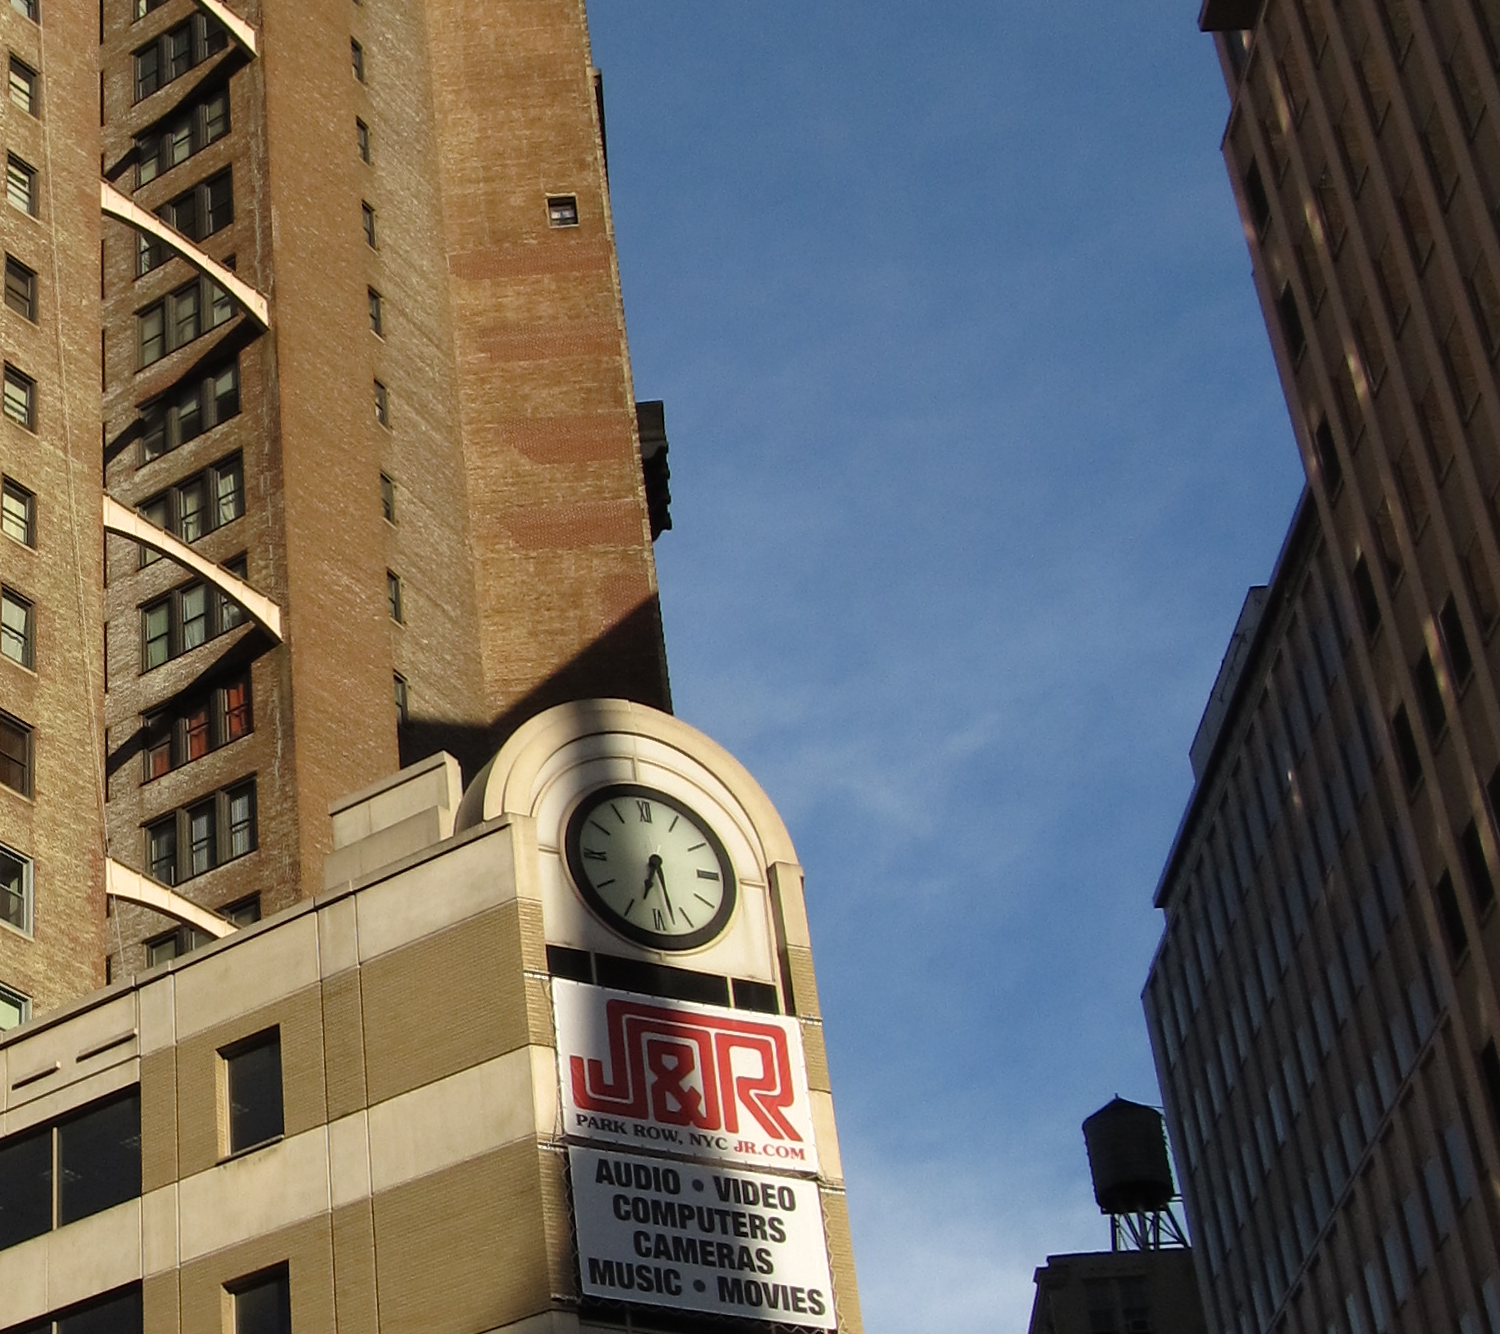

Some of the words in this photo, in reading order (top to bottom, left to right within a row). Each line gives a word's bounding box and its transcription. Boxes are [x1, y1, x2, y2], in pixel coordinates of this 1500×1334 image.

[570, 998, 803, 1142] J&R
[575, 1113, 628, 1139] PARK
[632, 1122, 684, 1147] ROW,
[688, 1131, 728, 1152] NYC
[733, 1138, 806, 1161] JR.COM
[595, 1157, 681, 1196] AUDIO
[712, 1174, 797, 1213] VIDEO
[612, 1192, 787, 1245] COMPUTERS
[632, 1229, 774, 1276] CAMERAS
[588, 1257, 683, 1298] MUSIC
[717, 1273, 827, 1319] MOVIES
